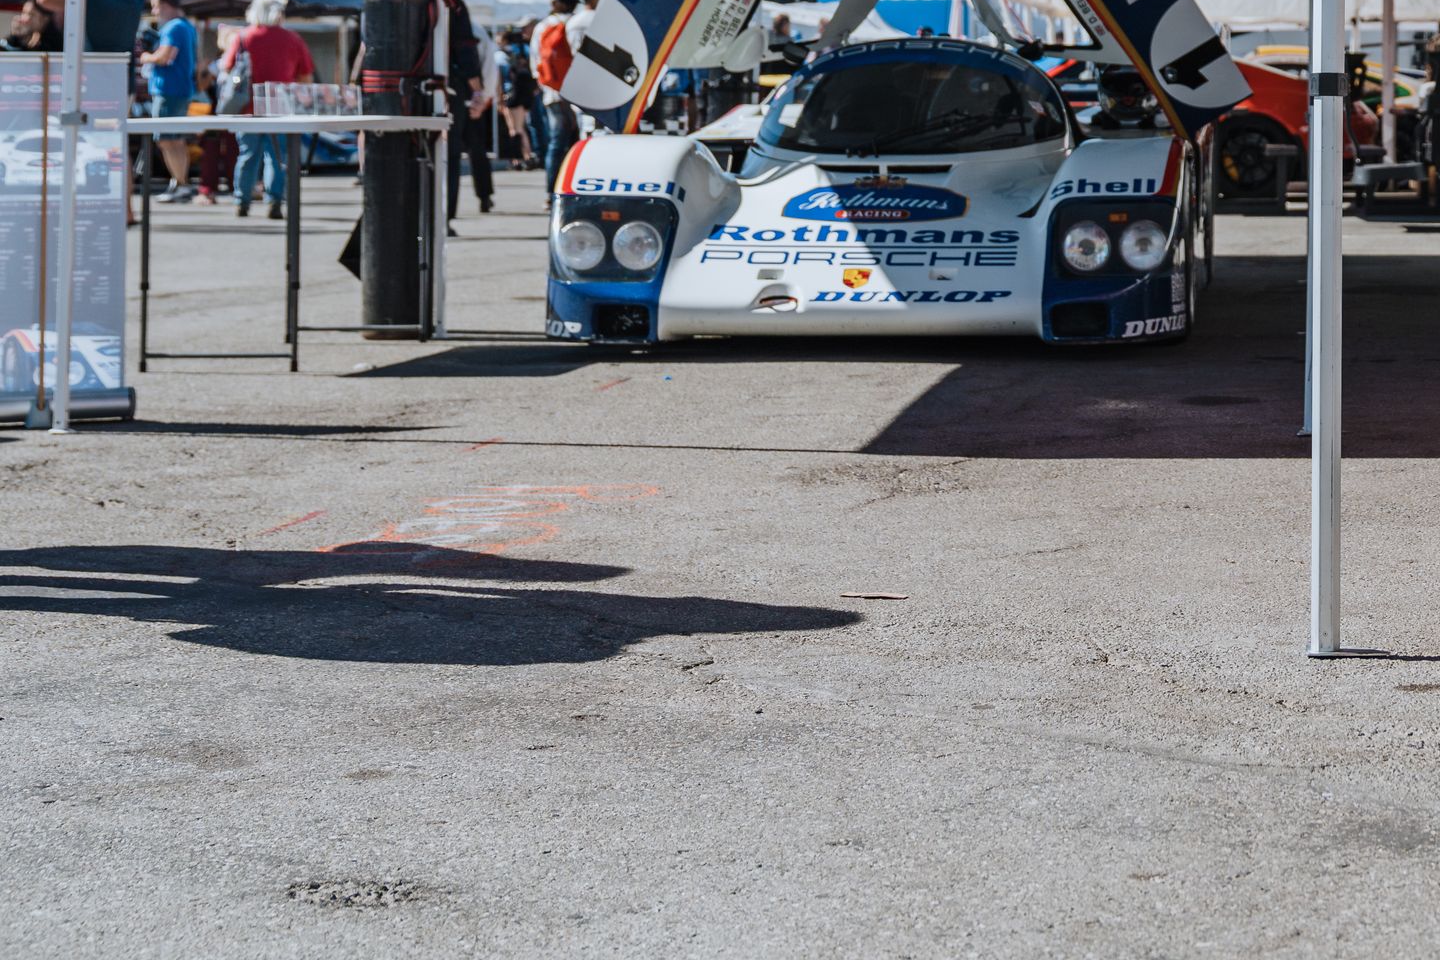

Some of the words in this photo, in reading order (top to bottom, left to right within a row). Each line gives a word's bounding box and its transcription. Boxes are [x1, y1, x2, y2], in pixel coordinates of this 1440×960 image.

[577, 178, 686, 202] Shell
[1050, 179, 1155, 200] Shell
[799, 191, 949, 211] Rothmans
[842, 210, 902, 218] RACING
[708, 224, 1020, 243] Rothmans
[700, 250, 1017, 266] PORSCHE
[809, 290, 1012, 302] DUNLOP
